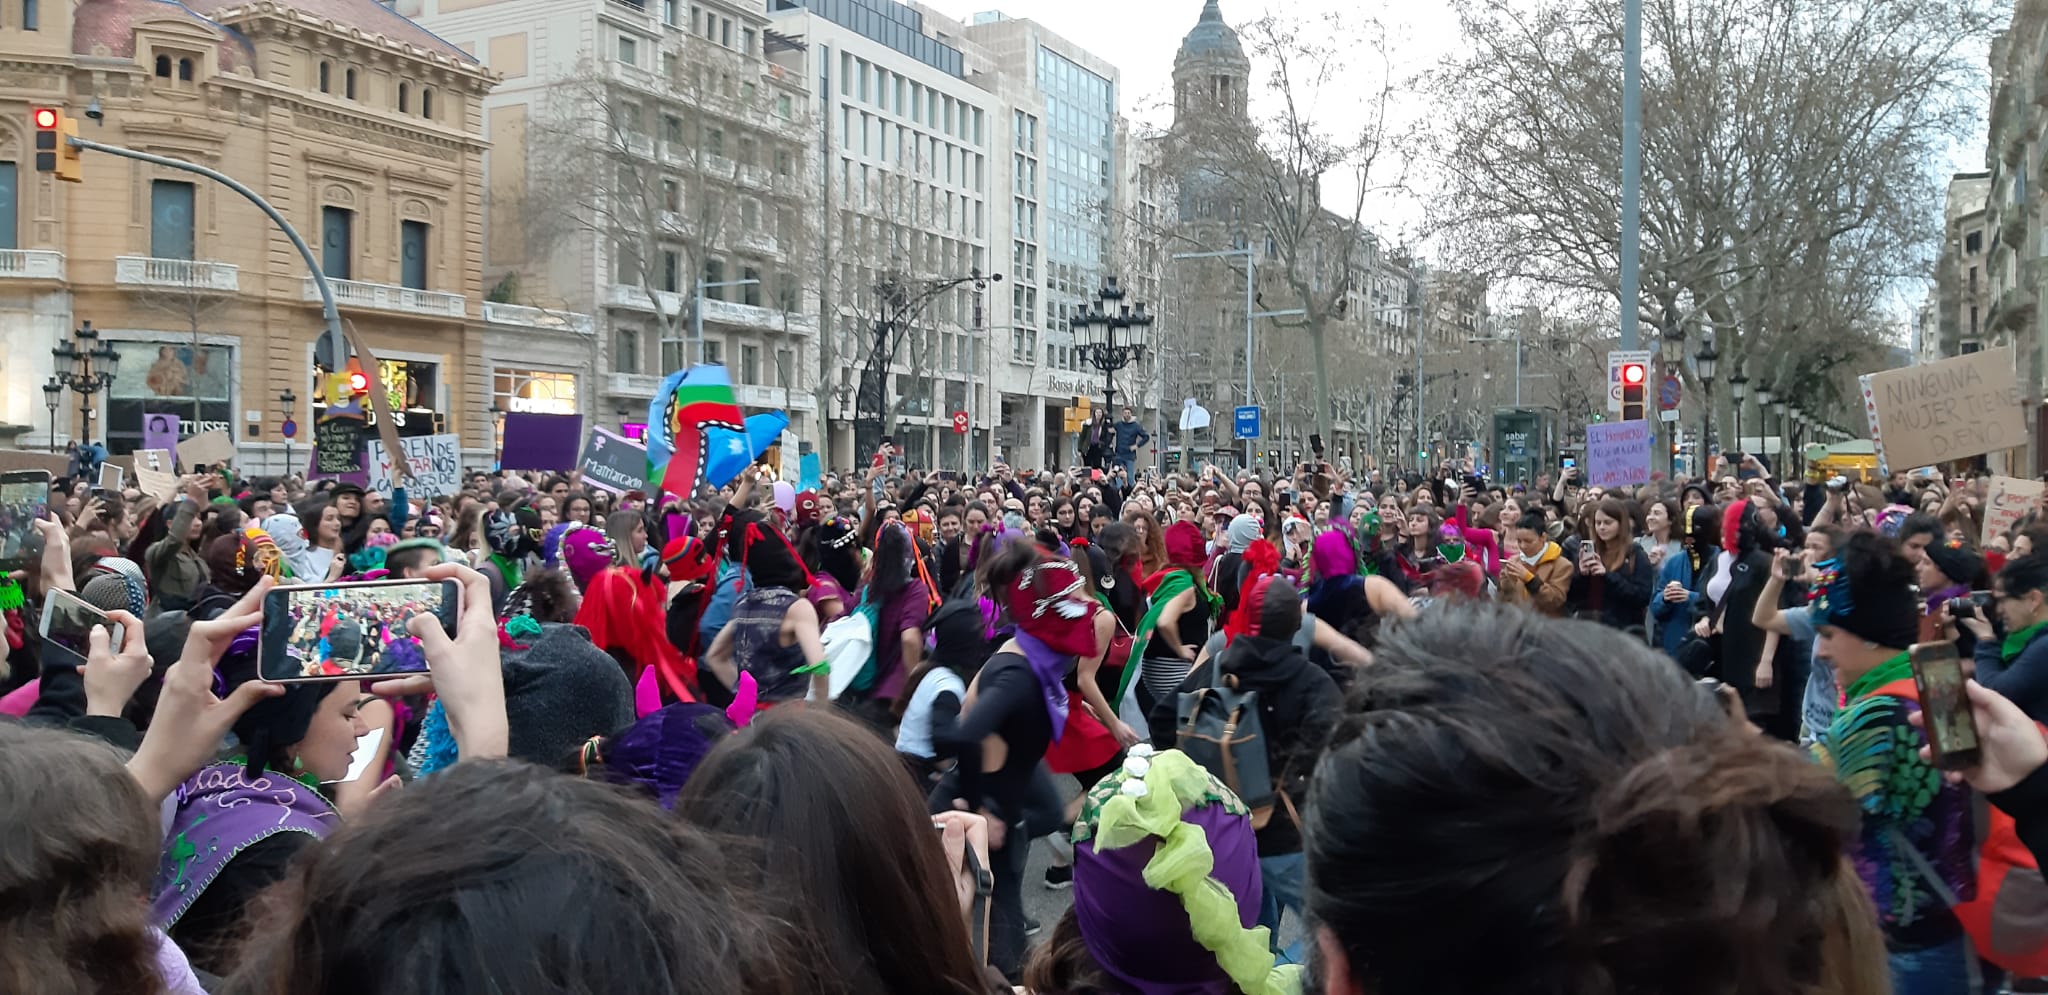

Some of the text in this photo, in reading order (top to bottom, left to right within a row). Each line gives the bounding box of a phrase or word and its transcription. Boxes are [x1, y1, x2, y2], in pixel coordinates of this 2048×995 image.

[1047, 374, 1073, 393] Borsa
[1886, 363, 1983, 408] NINGUNA
[1890, 399, 1962, 432] MUJER
[1505, 432, 1525, 441] saba
